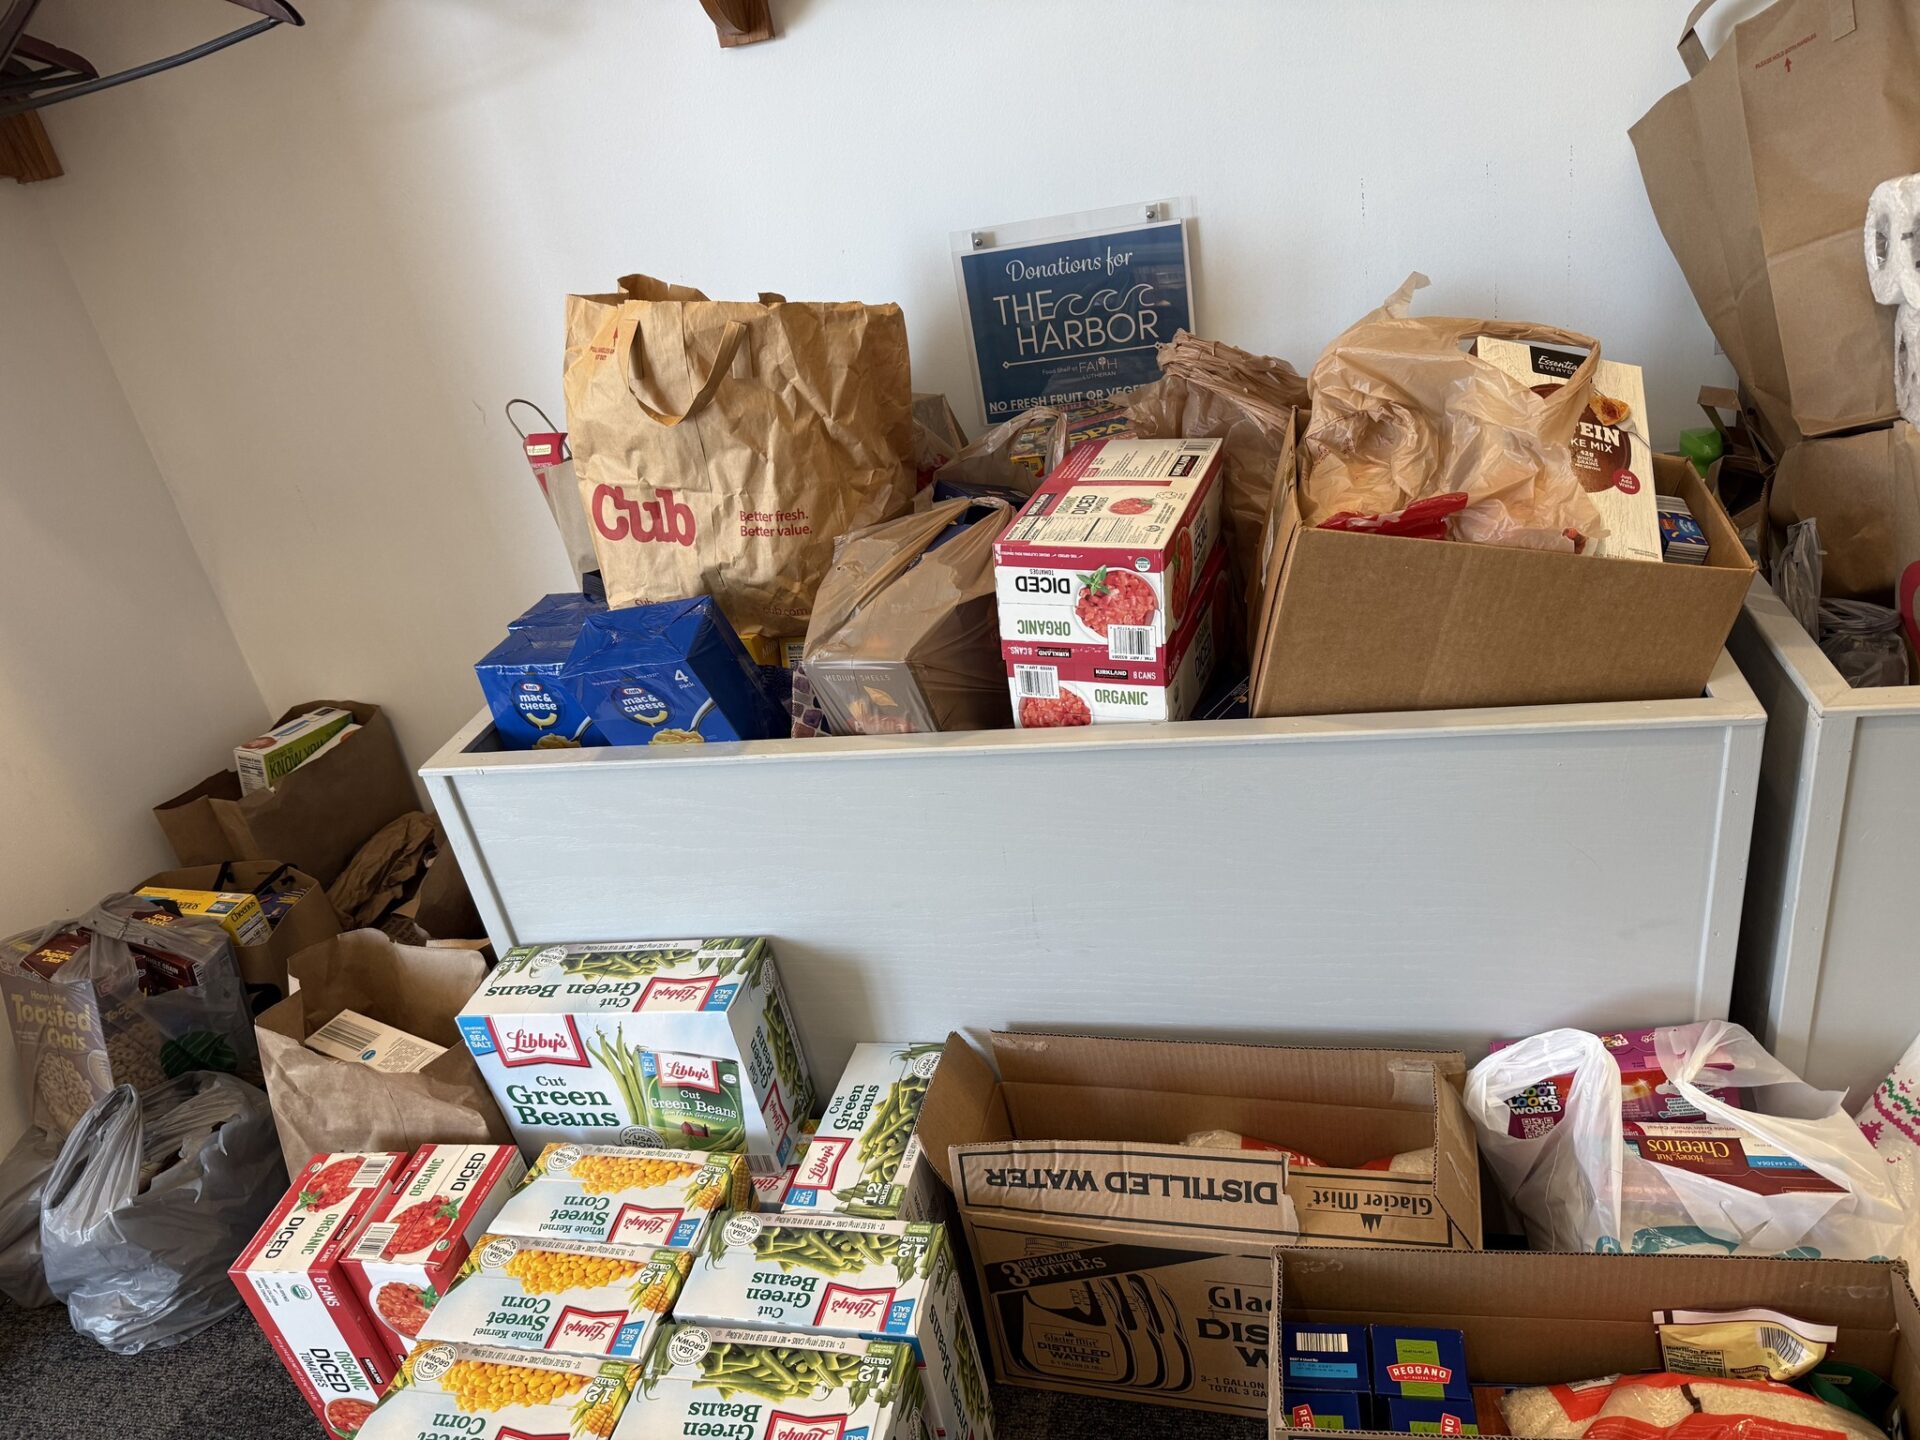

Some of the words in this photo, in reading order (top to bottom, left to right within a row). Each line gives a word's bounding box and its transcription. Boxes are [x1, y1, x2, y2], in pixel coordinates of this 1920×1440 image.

[1005, 256, 1102, 282] Donations
[1101, 246, 1133, 276] for
[993, 289, 1056, 325] THE
[1016, 309, 1159, 355] HARBOR
[1079, 357, 1118, 373] FAITH
[1538, 355, 1578, 371] Essentia
[1082, 371, 1117, 380] LUTHERAN
[990, 399, 1008, 413] NO
[1010, 395, 1048, 411] FRESH
[1050, 391, 1084, 405] FRUIT
[1086, 388, 1104, 400] OR
[1106, 384, 1146, 397] VEGE
[1577, 421, 1621, 447] EIN
[1571, 438, 1586, 448] KE
[1591, 440, 1613, 454] MIX
[1071, 494, 1098, 514] DICED
[592, 483, 696, 546] Cub
[739, 510, 773, 523] Better
[775, 508, 809, 521] fresh.
[740, 526, 776, 537] Better
[777, 524, 813, 537] value.
[1015, 576, 1071, 594] DICED
[1017, 619, 1071, 636] ORGANIC
[1038, 649, 1070, 657] KIRKLAND
[674, 669, 689, 682] 4
[859, 674, 891, 682] SHELLS
[1095, 669, 1127, 677] KIRKLAND
[1138, 672, 1157, 680] CANS
[519, 694, 542, 702] mac
[622, 696, 648, 705] mac
[1094, 688, 1149, 706] ORGANIC
[231, 901, 256, 922] Cheerios
[485, 983, 562, 998] Beans
[567, 981, 641, 997] Green
[652, 985, 707, 1003] Libby's
[599, 996, 630, 1007] Cut
[11, 993, 91, 1032] Toasted
[47, 1028, 86, 1050] Oats
[506, 1028, 569, 1054] Libby's
[750, 1037, 768, 1089] Green
[921, 1058, 931, 1070] USA
[923, 1054, 940, 1077] GROWN
[665, 1061, 710, 1082] Libby's
[536, 1075, 567, 1087] Cut
[506, 1084, 612, 1107] Green
[680, 1089, 701, 1100] Cut
[1508, 1096, 1558, 1107] LOOPS
[650, 1098, 691, 1110] Green
[694, 1100, 737, 1119] Beans
[829, 1095, 844, 1115] Cut
[833, 1084, 866, 1130] Green
[847, 1084, 880, 1132] Beans
[1511, 1105, 1562, 1116] WORLD
[513, 1105, 621, 1127] Beans
[624, 1139, 665, 1149] GROWN
[633, 1134, 652, 1142] USA
[1646, 1139, 1730, 1158] Cheerios
[808, 1145, 835, 1183] Libby's
[1656, 1153, 1673, 1161] Nut
[1675, 1153, 1704, 1163] Honey
[450, 1152, 486, 1191] DICED
[704, 1165, 726, 1173] cans
[409, 1158, 445, 1197] ORGANIC
[697, 1170, 721, 1186] 12
[984, 1168, 1099, 1193] WATER
[864, 1182, 882, 1205] 12
[1104, 1171, 1279, 1205] DISTILLED
[564, 1195, 610, 1211] Corn
[1364, 1193, 1433, 1216] Glacier
[550, 1209, 610, 1226] Sweet
[625, 1215, 672, 1234] Libby's
[301, 1213, 339, 1255] ORGANIC
[539, 1223, 573, 1234] Kernel
[574, 1225, 605, 1236] Whole
[729, 1221, 757, 1234] GROWN
[732, 1229, 747, 1238] USA
[265, 1217, 305, 1259] DICED
[902, 1236, 928, 1244] cans
[488, 1244, 513, 1257] GROWN
[490, 1251, 503, 1260] USA
[898, 1243, 925, 1258] 12
[647, 1262, 671, 1270] cans
[1018, 1255, 1040, 1268] ONE
[1040, 1251, 1082, 1265] GALLON
[1024, 1256, 1107, 1279] BOTTLES
[640, 1269, 667, 1285] 12
[751, 1272, 819, 1292] Beans
[1001, 1262, 1030, 1287] 3
[317, 1285, 340, 1307] CANS
[746, 1288, 812, 1308] Green
[501, 1296, 551, 1314] Corn
[758, 1306, 784, 1318] Cut
[831, 1297, 884, 1319] Libby's
[487, 1311, 550, 1331] Sweet
[473, 1328, 509, 1339] Kernel
[510, 1330, 543, 1342] Whole
[565, 1321, 615, 1340] Libby's
[700, 1331, 709, 1343] NON
[1196, 1318, 1269, 1345] DIS
[675, 1336, 706, 1351] GROWN
[791, 1337, 806, 1345] CANS
[929, 1304, 952, 1384] Beans
[679, 1345, 694, 1356] USA
[1037, 1342, 1111, 1358] DISTILLED
[1050, 1351, 1101, 1364] WATER
[1666, 1345, 1697, 1354] Nutrition
[423, 1353, 450, 1368] GROWN
[424, 1361, 438, 1372] USA
[863, 1356, 892, 1365] cans
[1668, 1362, 1696, 1370] Calories
[299, 1352, 328, 1388] TOMATOES
[309, 1348, 350, 1393] DICED
[334, 1351, 369, 1391] ORGANIC
[858, 1365, 888, 1383] 12
[1392, 1366, 1447, 1379] REGGANO
[594, 1376, 620, 1386] cans
[1223, 1378, 1264, 1390] GALLON
[584, 1386, 616, 1404] 12
[1208, 1383, 1241, 1395] TOTAL
[1243, 1388, 1250, 1396] 3
[687, 1401, 763, 1422] Beans
[432, 1413, 486, 1435] Corn
[683, 1421, 755, 1440] Green
